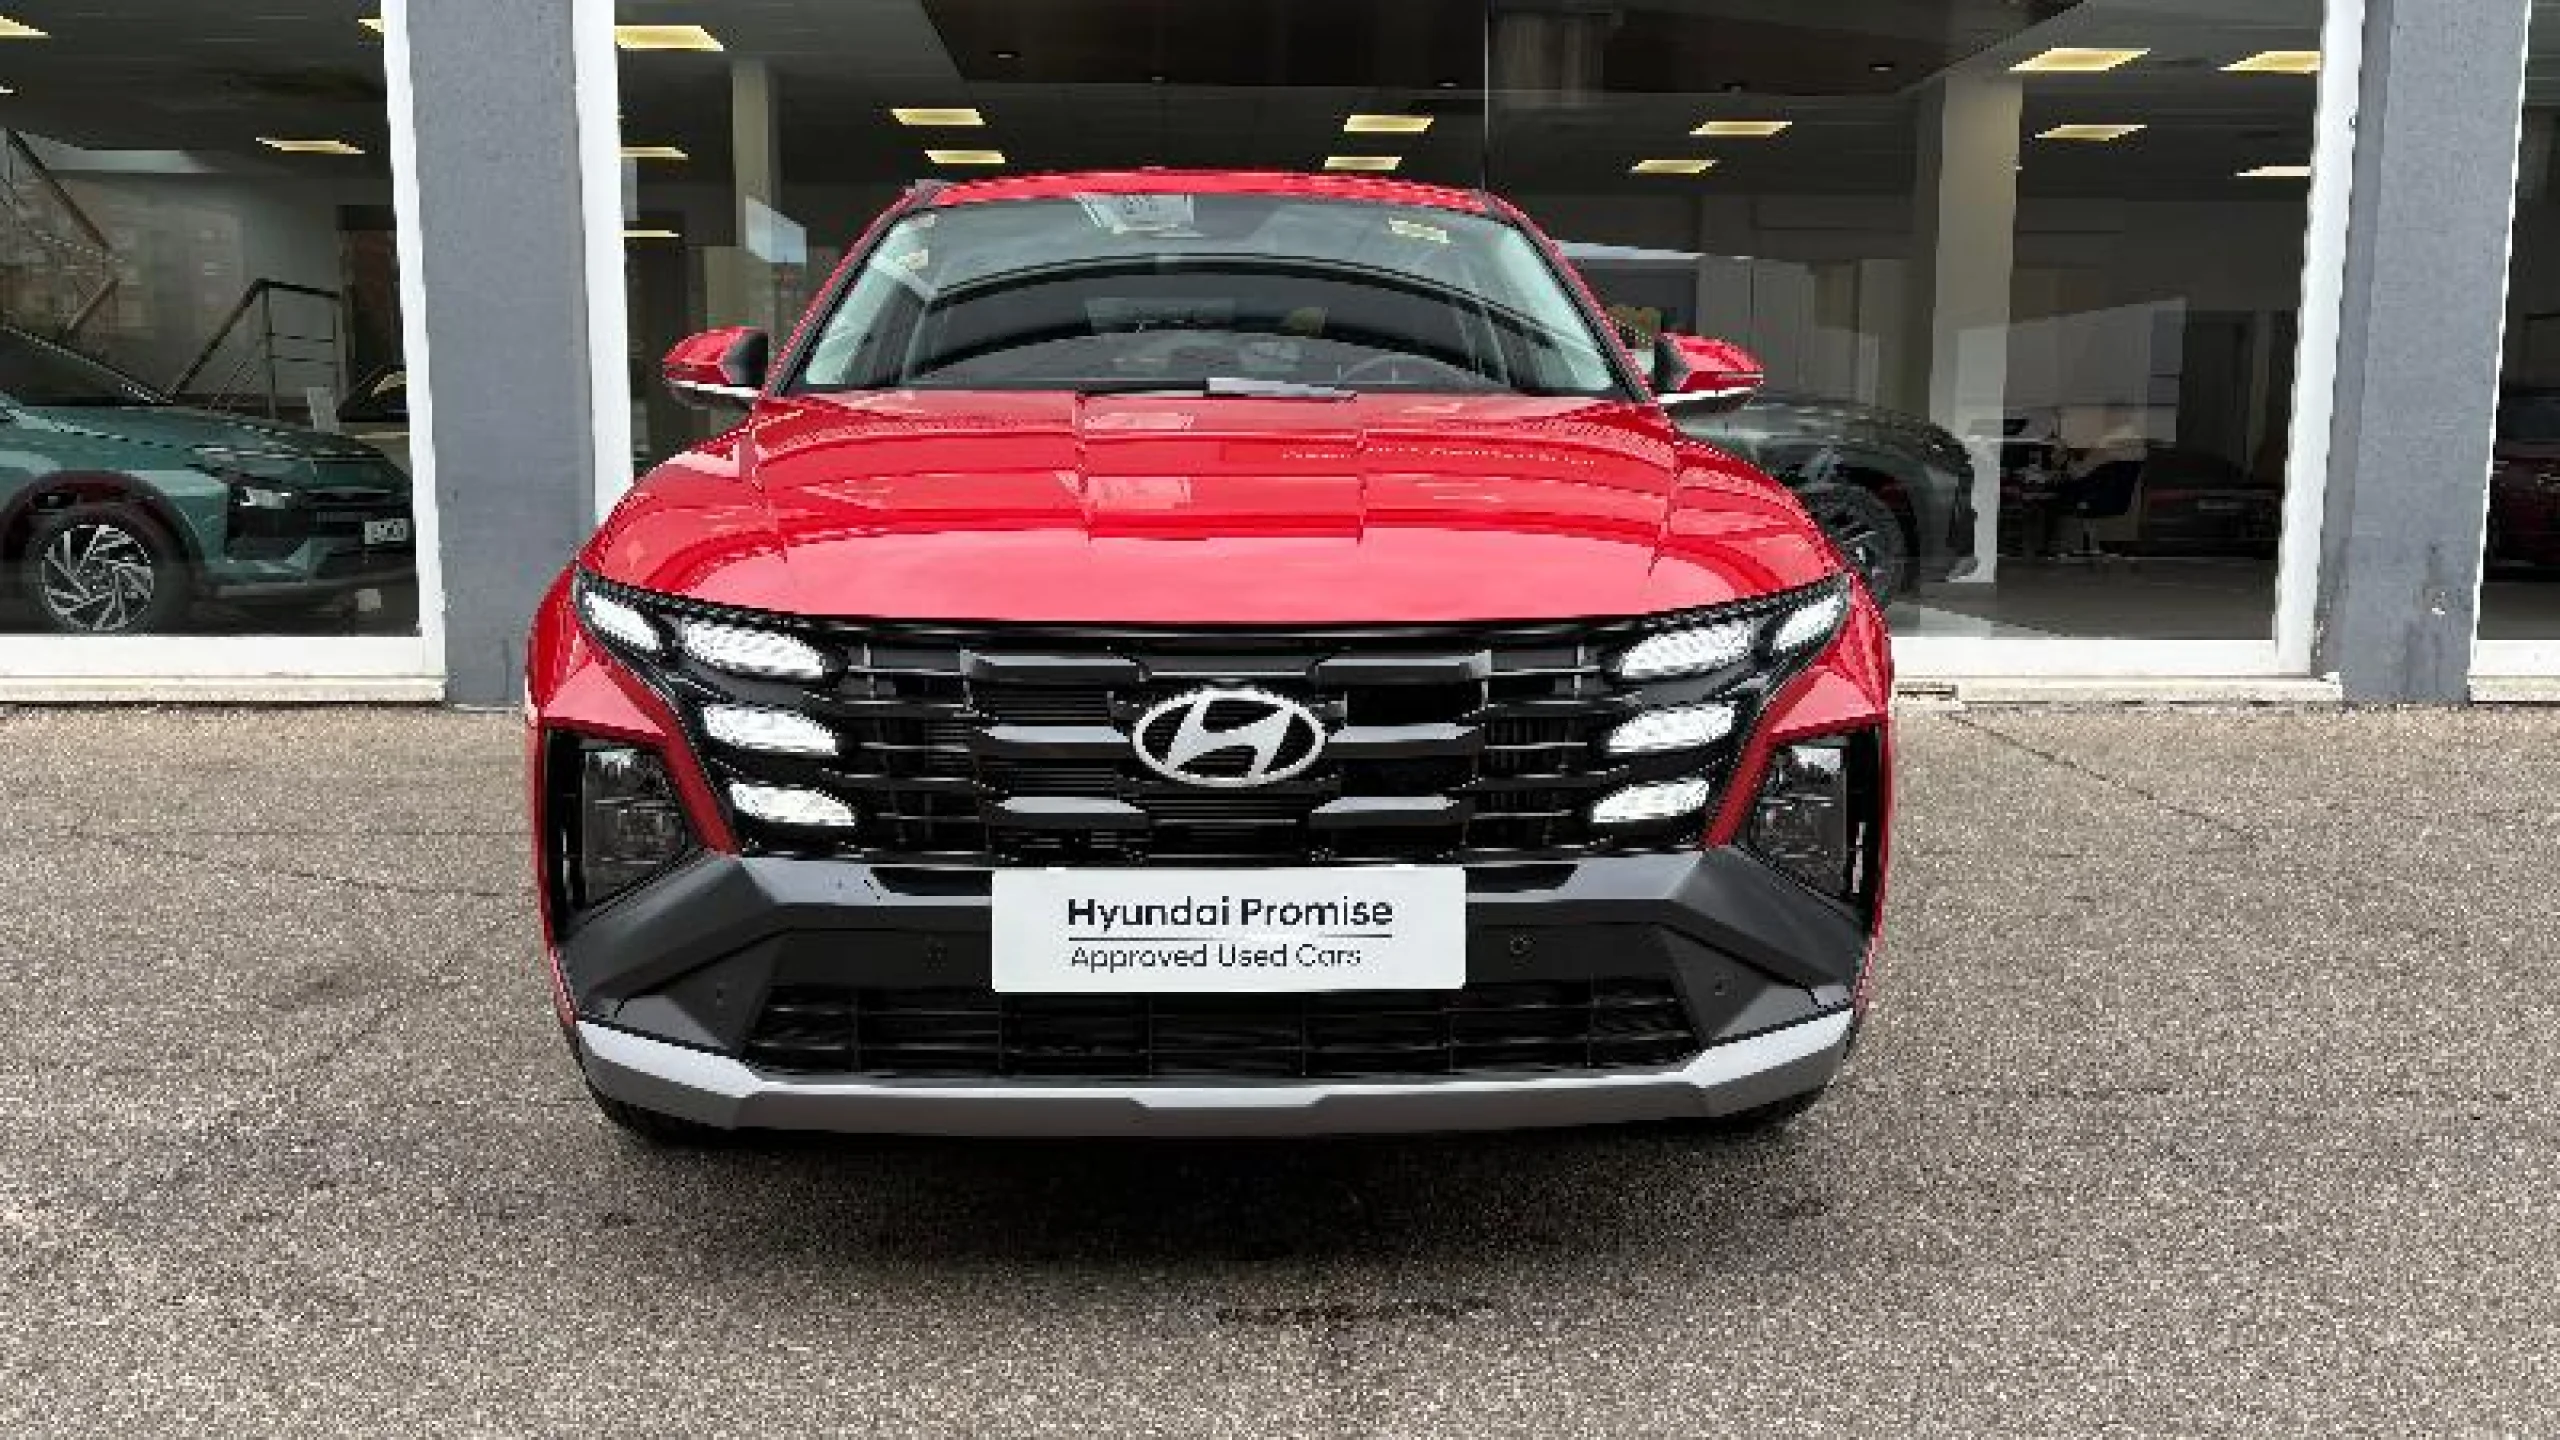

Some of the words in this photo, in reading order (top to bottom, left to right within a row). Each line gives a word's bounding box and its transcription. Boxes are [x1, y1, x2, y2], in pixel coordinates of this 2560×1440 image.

[1068, 895, 1229, 931] Hyundai
[1240, 895, 1393, 926] Promise
[1070, 943, 1206, 973] Approved
[1218, 943, 1287, 967] Used
[1295, 943, 1362, 967] Cars
